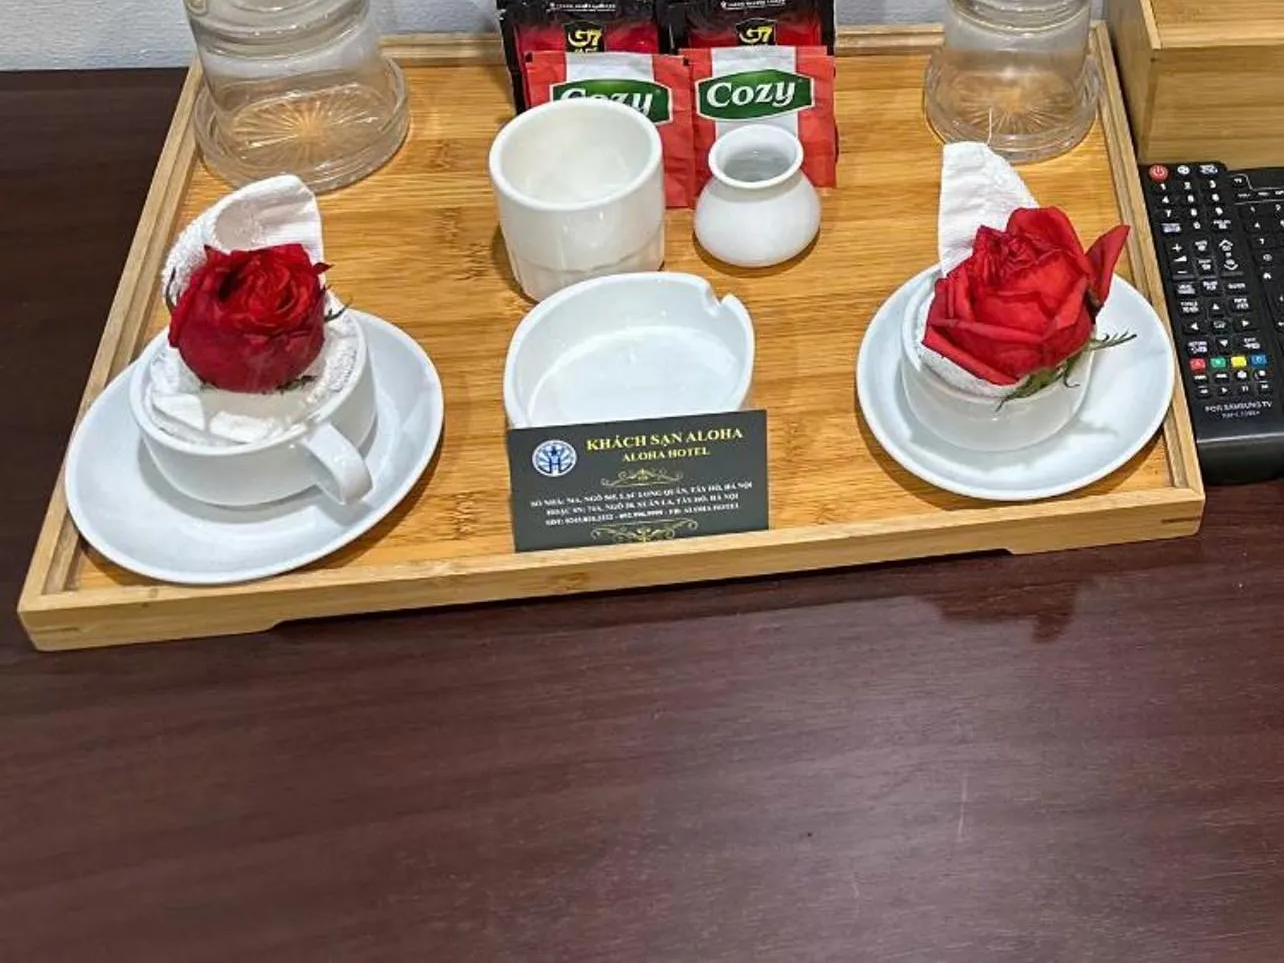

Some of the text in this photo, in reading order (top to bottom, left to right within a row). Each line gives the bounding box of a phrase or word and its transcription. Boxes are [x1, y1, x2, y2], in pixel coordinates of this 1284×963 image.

[739, 24, 773, 44] G7
[706, 81, 796, 108] Cozy
[1262, 400, 1272, 408] TV
[586, 428, 744, 451] KHÁCH SẠN ALOHA
[622, 447, 711, 462] ALOHA HOTEL
